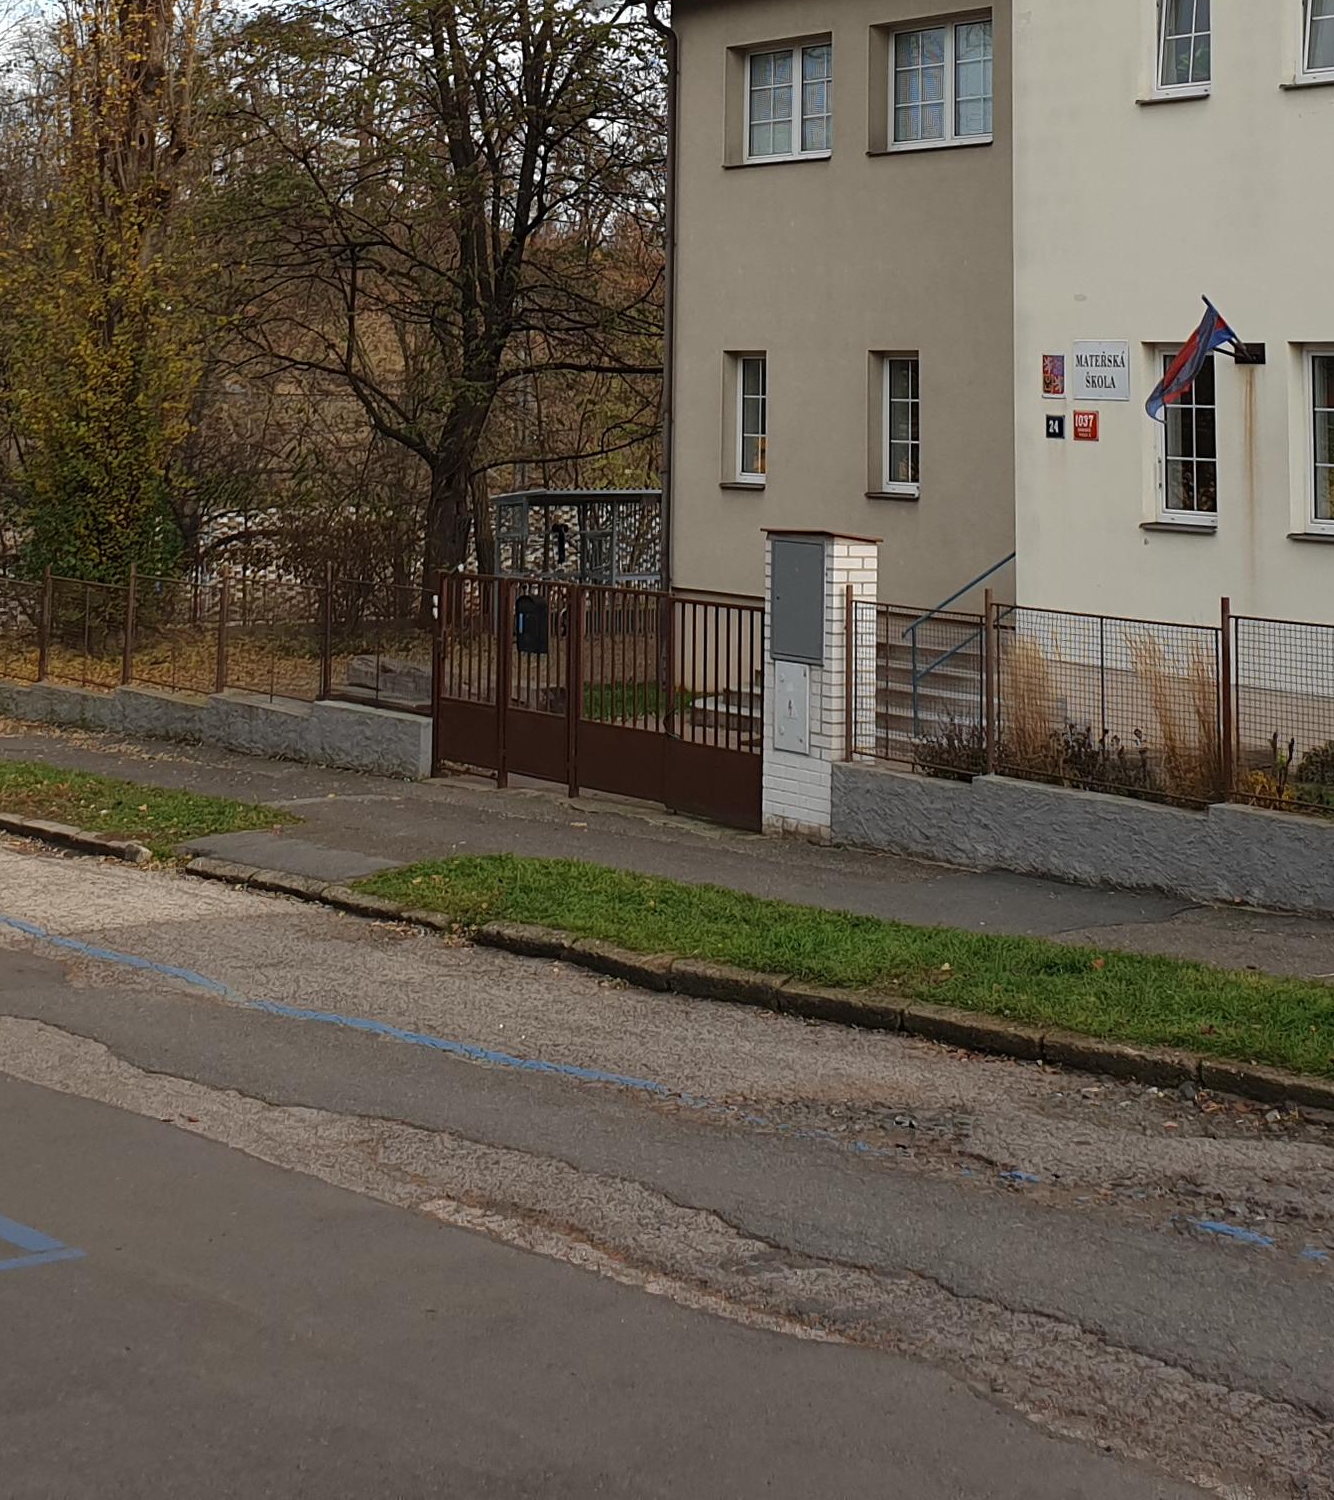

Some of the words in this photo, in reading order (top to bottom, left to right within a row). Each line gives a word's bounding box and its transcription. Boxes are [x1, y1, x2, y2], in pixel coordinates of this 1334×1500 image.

[1075, 351, 1125, 368] MATEŘSKÁ
[1085, 371, 1116, 389] ŠKOLA
[1048, 419, 1059, 433] 24
[1075, 414, 1094, 428] 1037
